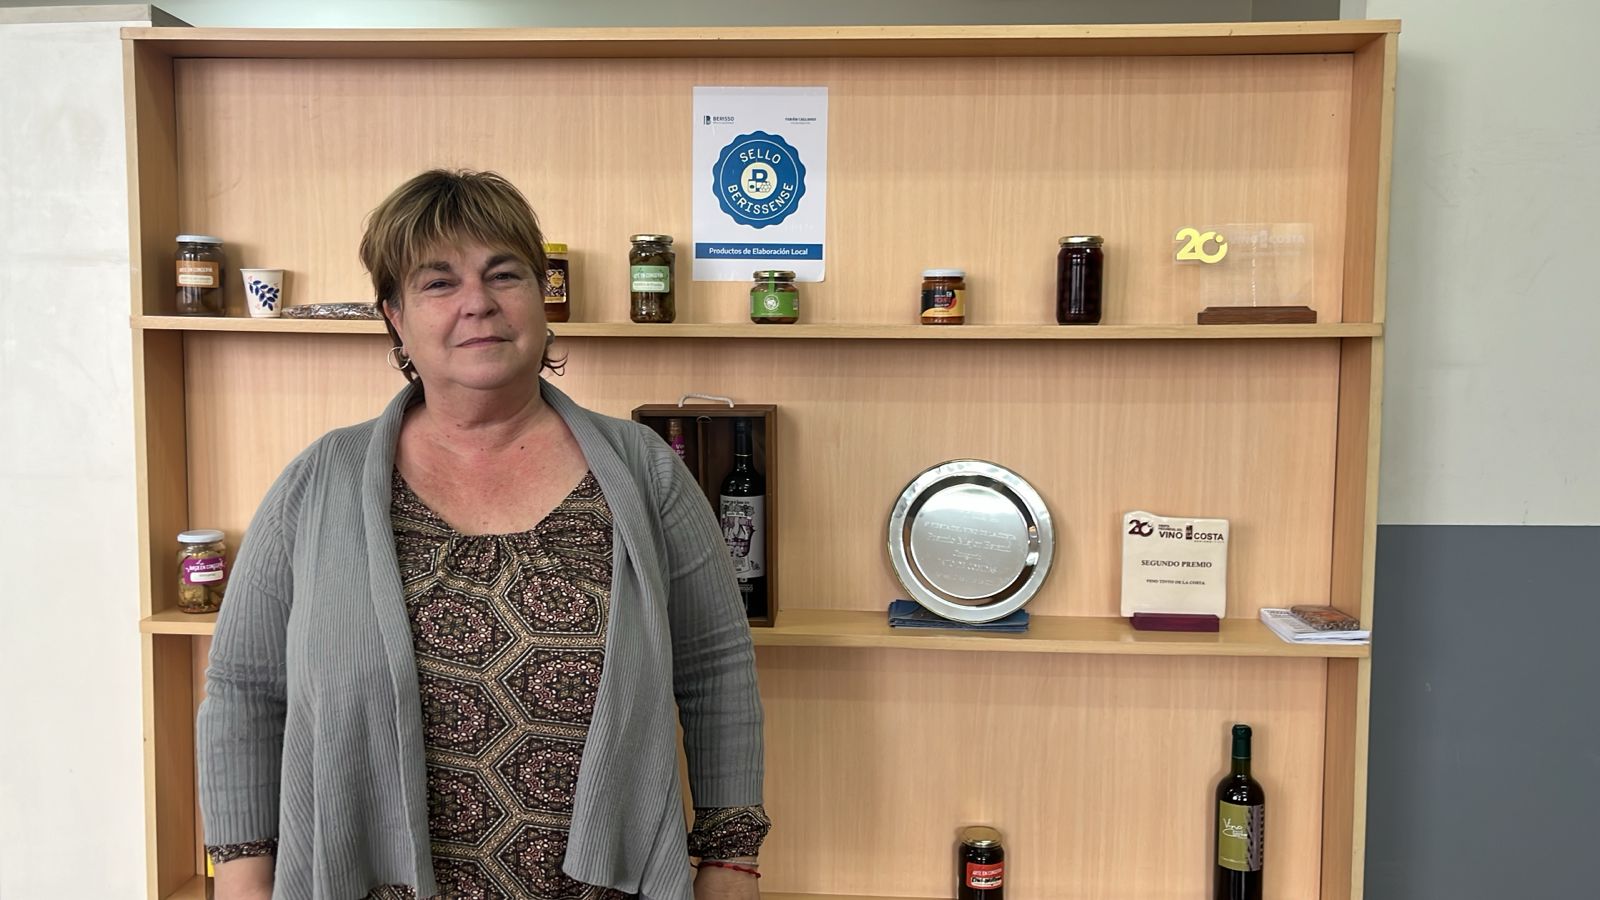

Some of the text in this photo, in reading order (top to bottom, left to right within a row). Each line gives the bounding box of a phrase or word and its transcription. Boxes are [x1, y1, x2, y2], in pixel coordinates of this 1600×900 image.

[739, 148, 781, 164] SELLO
[727, 182, 794, 215] BERISSENSE
[709, 247, 742, 255] Productos
[743, 247, 751, 255] de
[752, 247, 790, 255] Elaboración
[1175, 227, 1229, 264] 20
[1128, 519, 1154, 537] 20
[1159, 531, 1183, 539] VINO
[1193, 532, 1224, 541] COSTA
